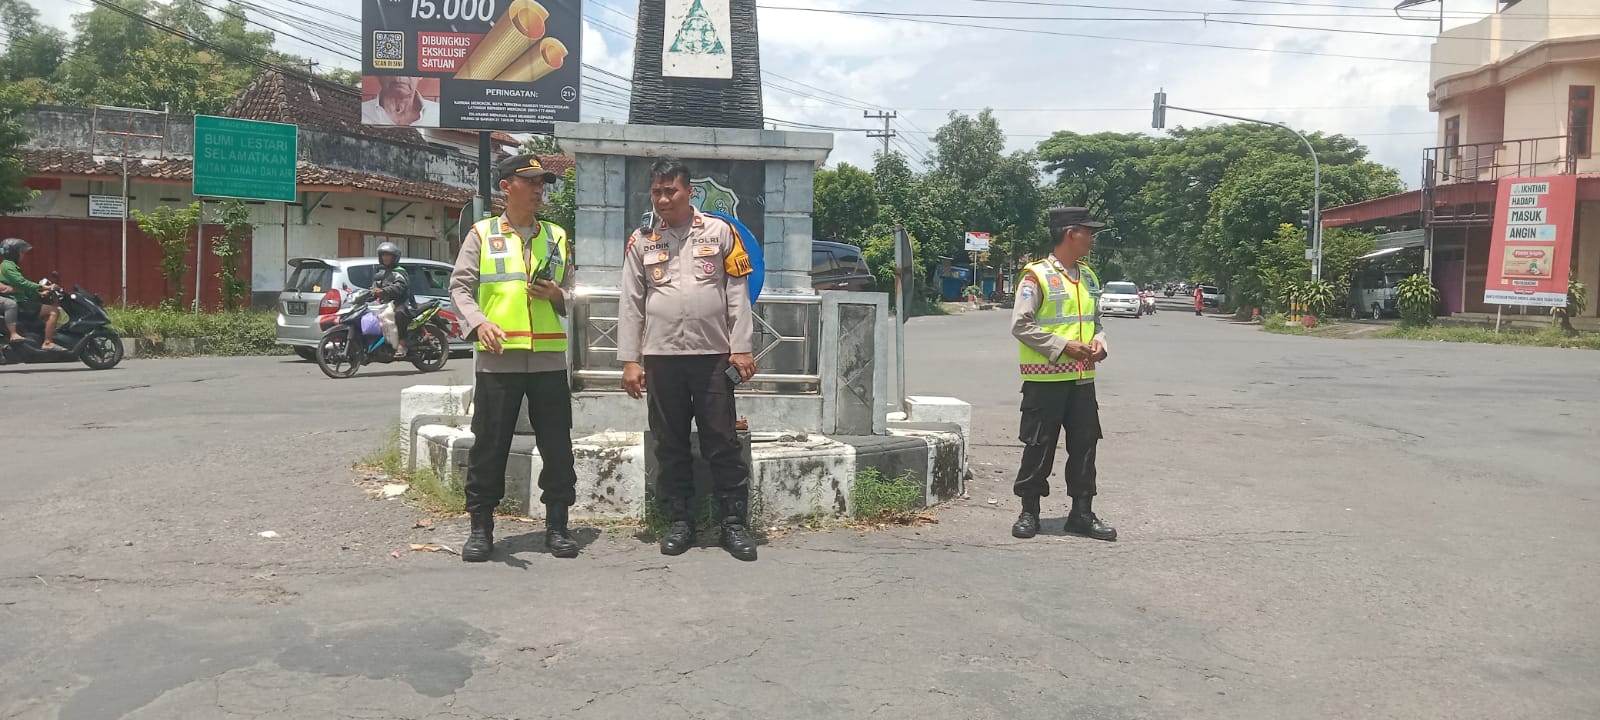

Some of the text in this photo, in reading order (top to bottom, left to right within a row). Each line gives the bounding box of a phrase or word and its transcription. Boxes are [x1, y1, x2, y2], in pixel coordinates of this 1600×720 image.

[411, 0, 495, 22] 15.000
[422, 35, 470, 47] DIBUNGKUS
[422, 47, 467, 58] EKSKLUSIF
[422, 58, 455, 69] SATUAN
[204, 133, 288, 152] BUMI LESTARI
[204, 147, 288, 165] SELAMATKAN
[1511, 196, 1536, 206] HADAPI
[1511, 210, 1542, 222] MASUK
[1509, 227, 1537, 239] ANGIN
[692, 237, 719, 245] POLRI
